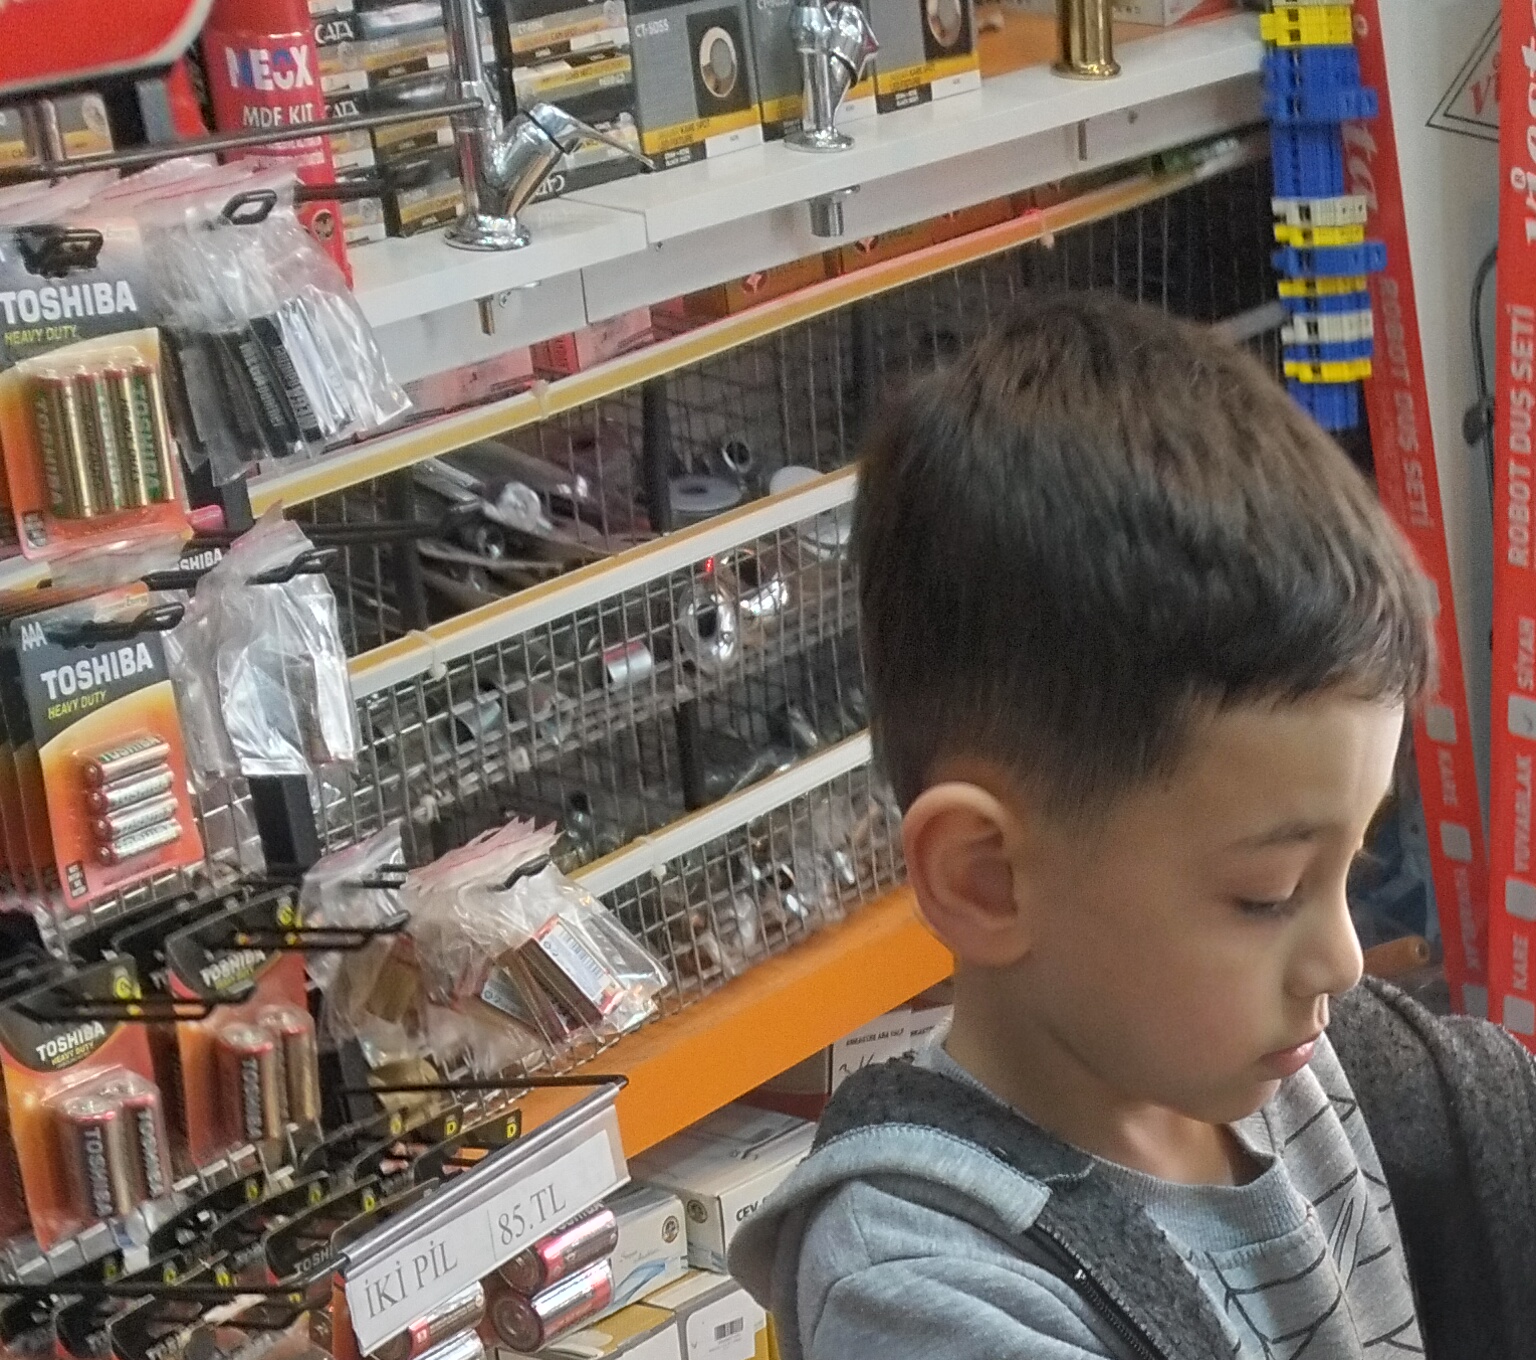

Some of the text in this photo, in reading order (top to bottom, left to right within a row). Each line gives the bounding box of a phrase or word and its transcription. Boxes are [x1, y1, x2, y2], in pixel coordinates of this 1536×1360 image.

[314, 20, 354, 44] CATA
[224, 45, 314, 91] NEOX
[243, 103, 314, 128] MDF KIT
[1, 280, 137, 324] TOSHIBA
[5, 325, 77, 345] HEAVY DUTY
[1508, 462, 1531, 567] ROBOT
[177, 548, 223, 571] SHIBA
[20, 621, 48, 651] AAA
[40, 642, 154, 700] TOSHIBA
[47, 690, 107, 720] HEAVY DUTY
[100, 736, 163, 762] TOSHIBA
[35, 1020, 106, 1062] TOSHIBA
[506, 1121, 517, 1138] D
[84, 1127, 112, 1216] TOSHIBA
[497, 1184, 567, 1247] 85.TL
[292, 1246, 333, 1275] TOSHI
[364, 1241, 458, 1319] İKİ PİL
